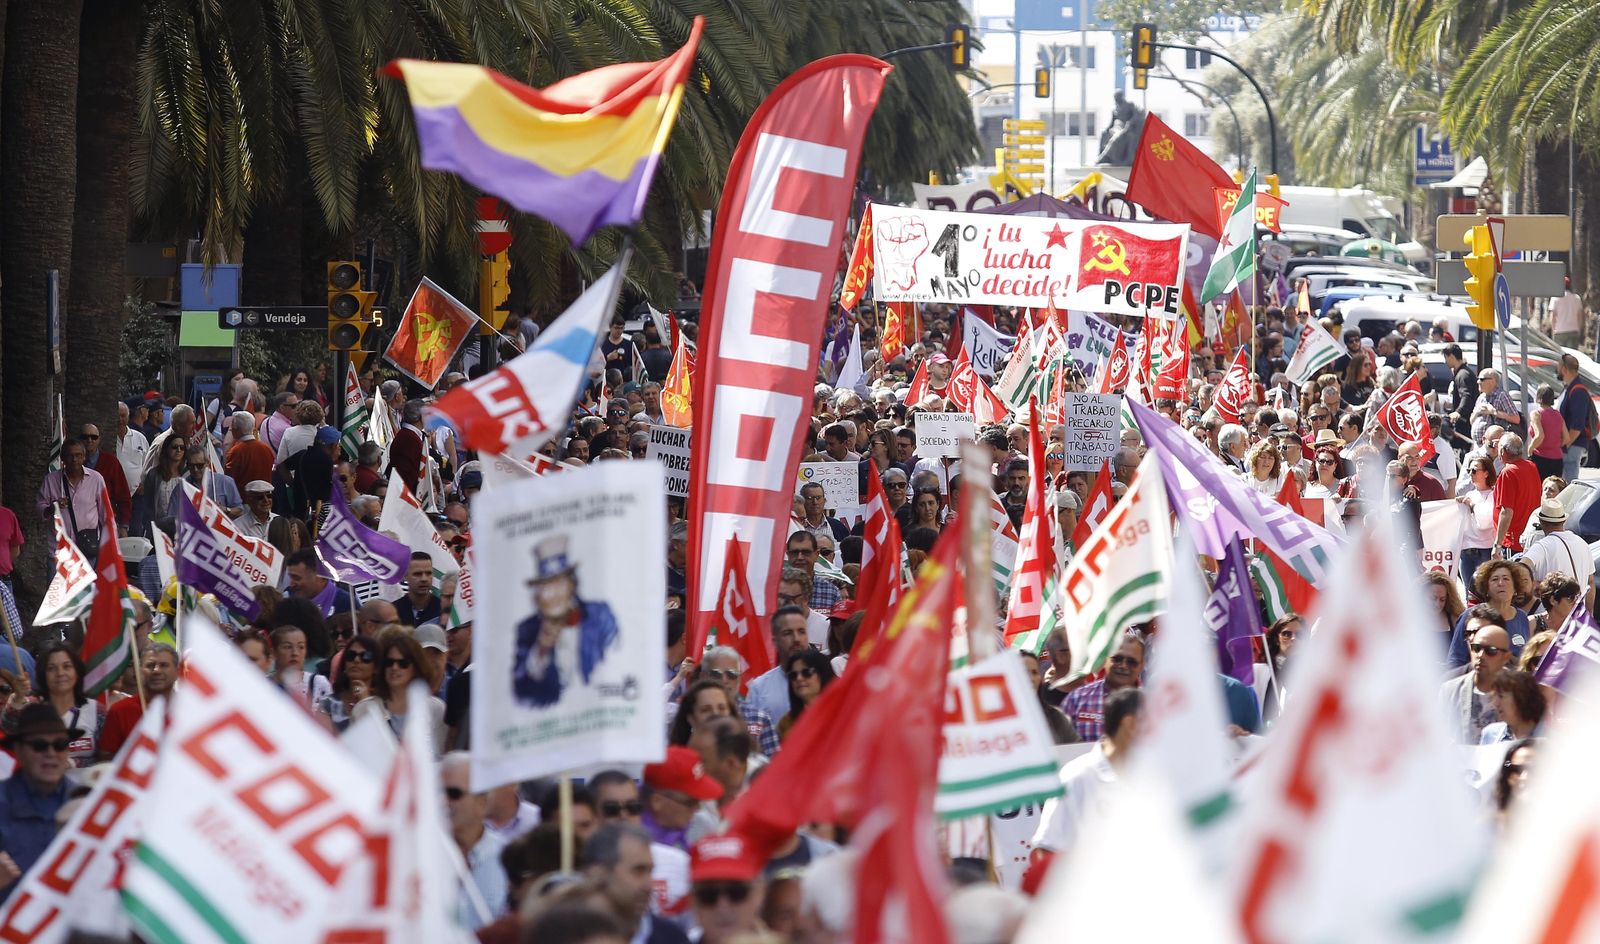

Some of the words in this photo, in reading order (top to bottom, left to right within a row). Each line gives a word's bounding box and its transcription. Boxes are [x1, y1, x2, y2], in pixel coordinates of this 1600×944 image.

[984, 248, 1052, 269] lucha
[931, 269, 980, 300] MAYO
[982, 273, 1071, 298] decide!
[1104, 280, 1180, 314] PCPE
[264, 313, 306, 325] Vendeja
[698, 132, 848, 617] CCOO
[1073, 395, 1089, 404] NO
[1090, 396, 1103, 404] AL
[918, 414, 950, 422] TRABAJO
[1072, 404, 1116, 417] TRABAJO
[650, 429, 686, 448] LUCHAR
[1097, 432, 1113, 441] AL
[1068, 441, 1115, 453] TRABAJO
[224, 545, 269, 585] Málaga
[214, 581, 251, 612] Málaga
